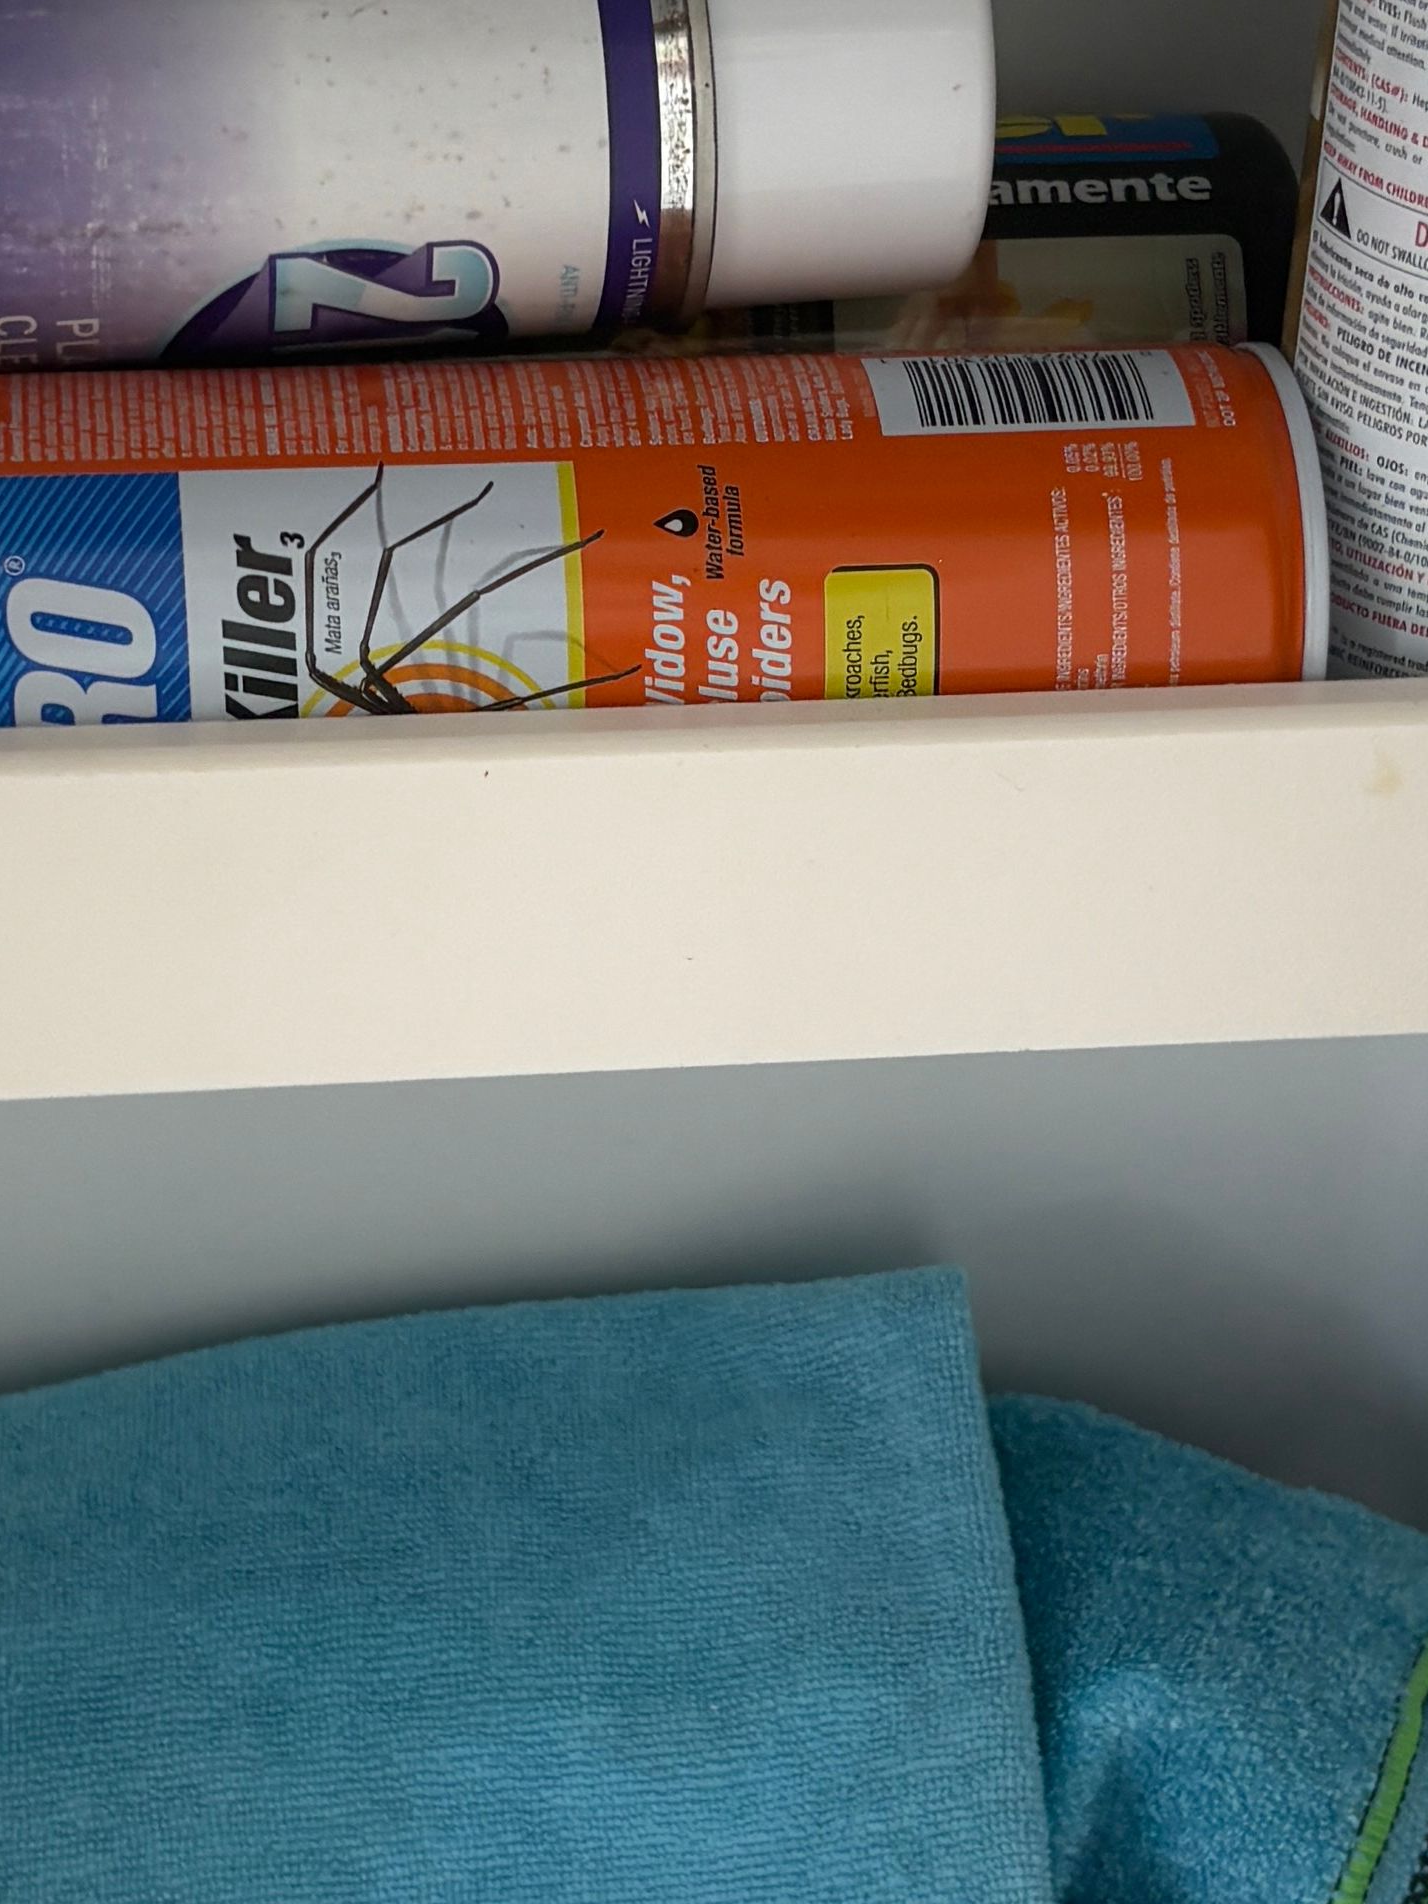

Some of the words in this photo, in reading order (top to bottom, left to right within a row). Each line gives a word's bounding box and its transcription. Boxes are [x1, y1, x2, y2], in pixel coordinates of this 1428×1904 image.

[1357, 228, 1369, 246] DO
[1371, 235, 1389, 256] NOT
[56, 318, 100, 366] PL
[1378, 349, 1391, 364] DE
[1406, 429, 1427, 447] POR
[1376, 455, 1409, 477] OJOS:
[701, 463, 725, 581] Water-based
[724, 484, 746, 558] formula
[1416, 570, 1423, 583] Y
[324, 614, 343, 655] Mata
[698, 608, 739, 701] luse
[896, 614, 922, 697] Bedbugs.
